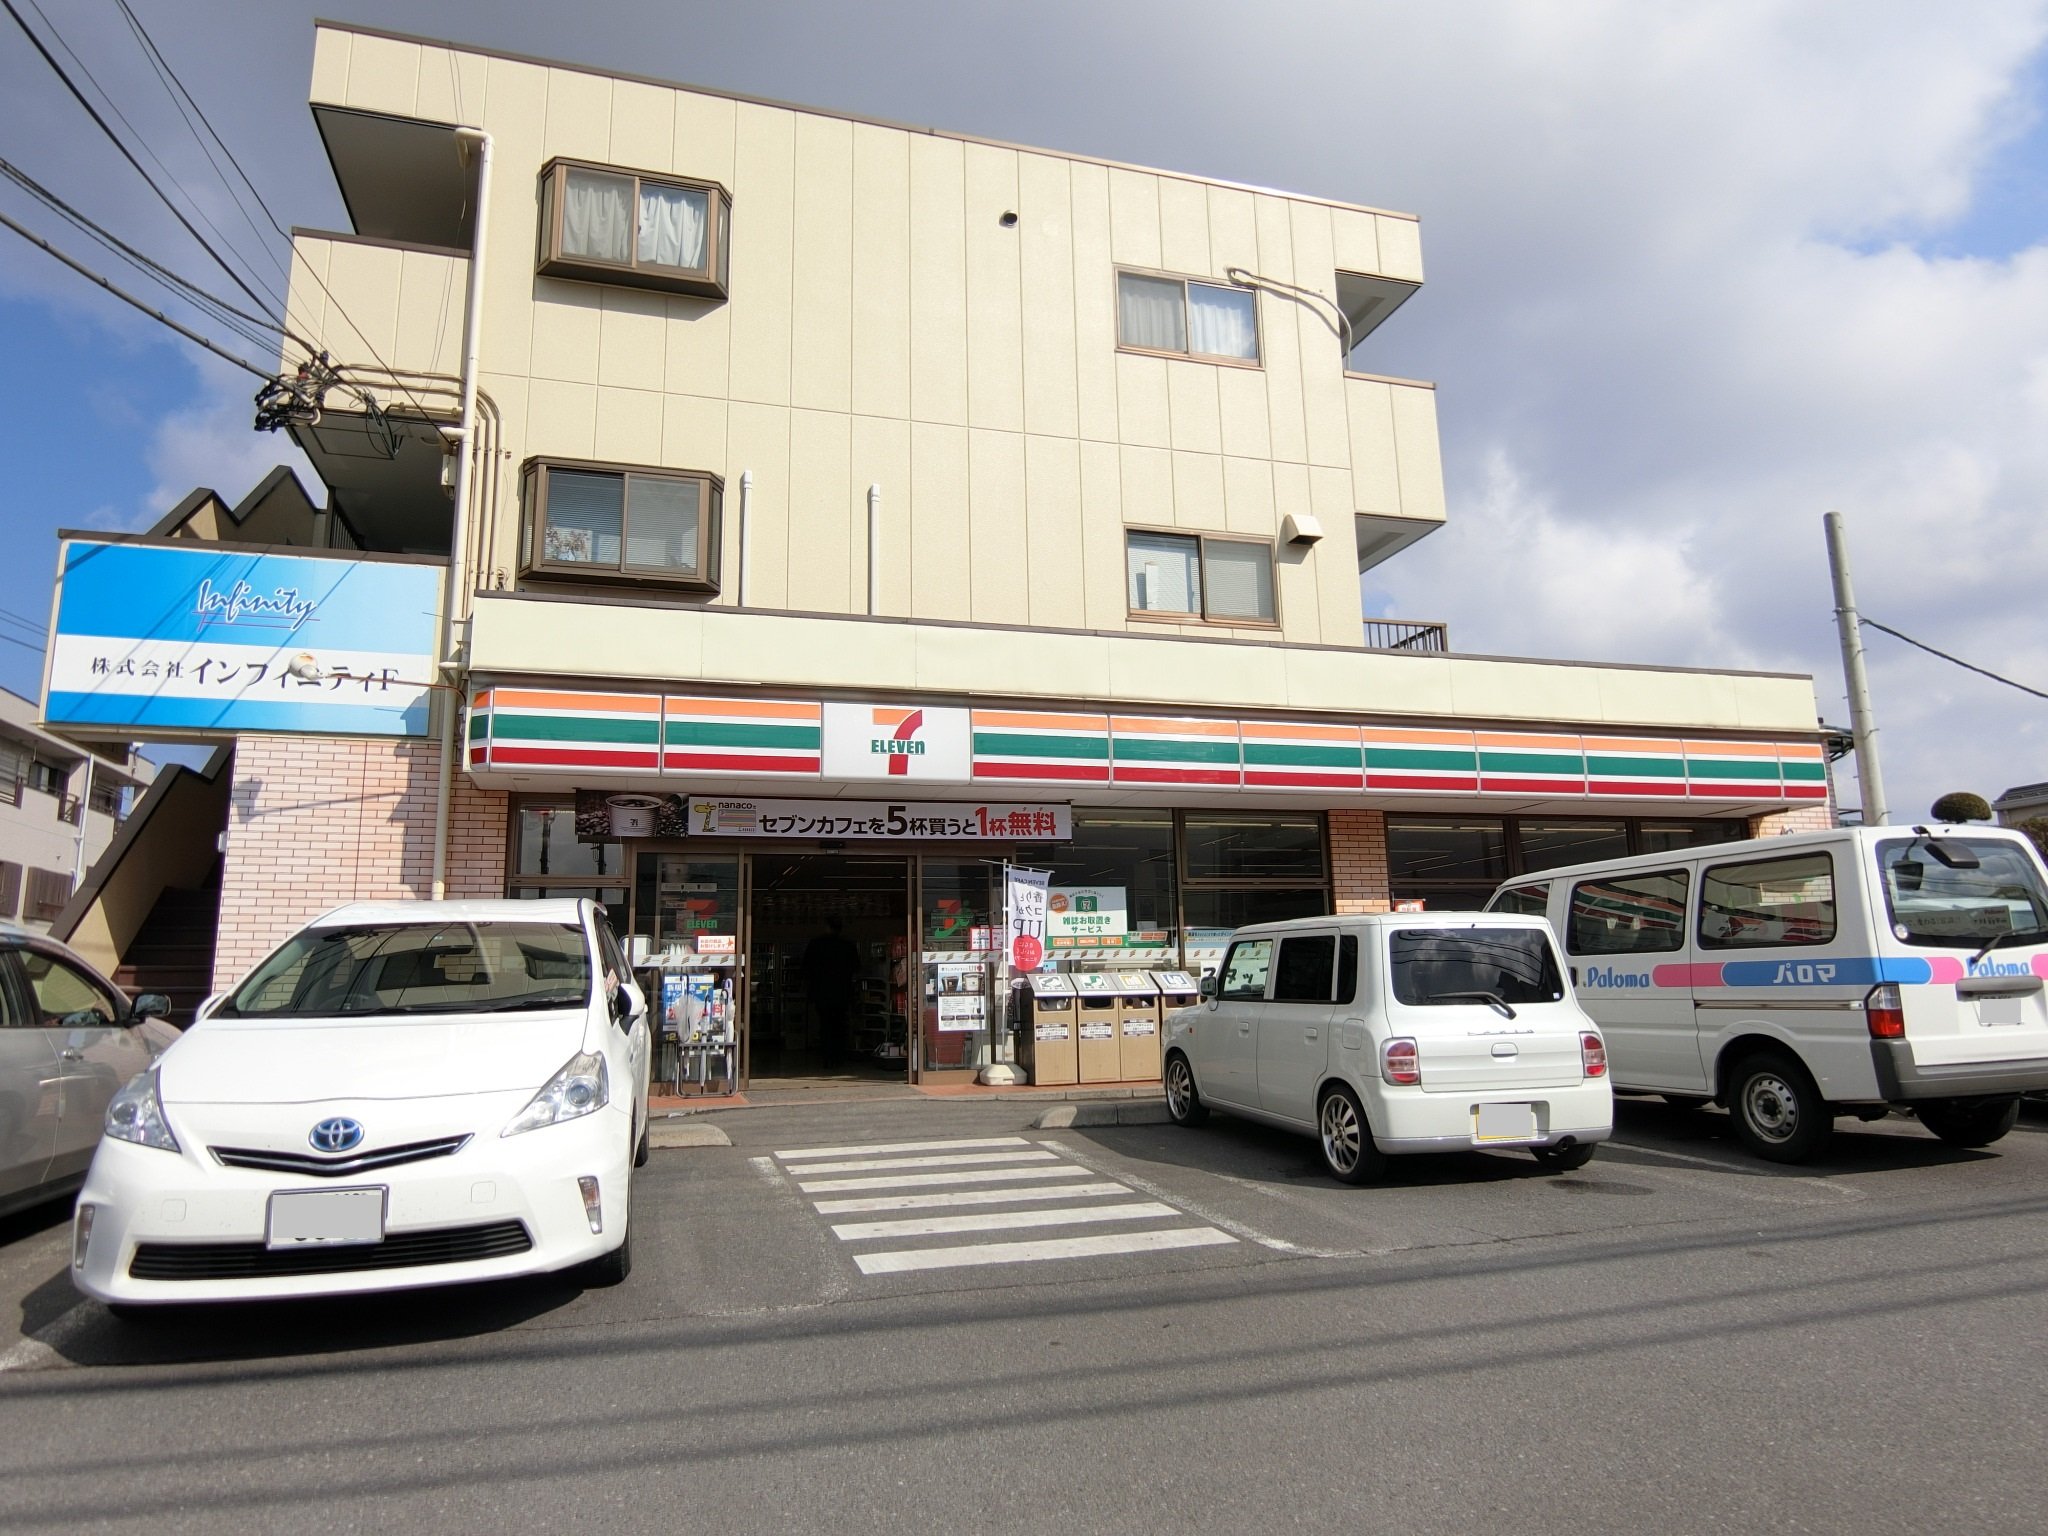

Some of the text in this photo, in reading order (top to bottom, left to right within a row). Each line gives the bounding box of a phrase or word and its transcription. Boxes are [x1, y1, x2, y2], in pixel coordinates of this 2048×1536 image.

[197, 579, 317, 631] Infinity
[718, 802, 752, 810] nanaco
[1062, 916, 1112, 925] 雑誌お取置き
[1071, 925, 1103, 933] サービス
[1587, 966, 1649, 988] Paloma
[1773, 962, 1836, 984] パロマ
[1965, 956, 2029, 977] Paloma
